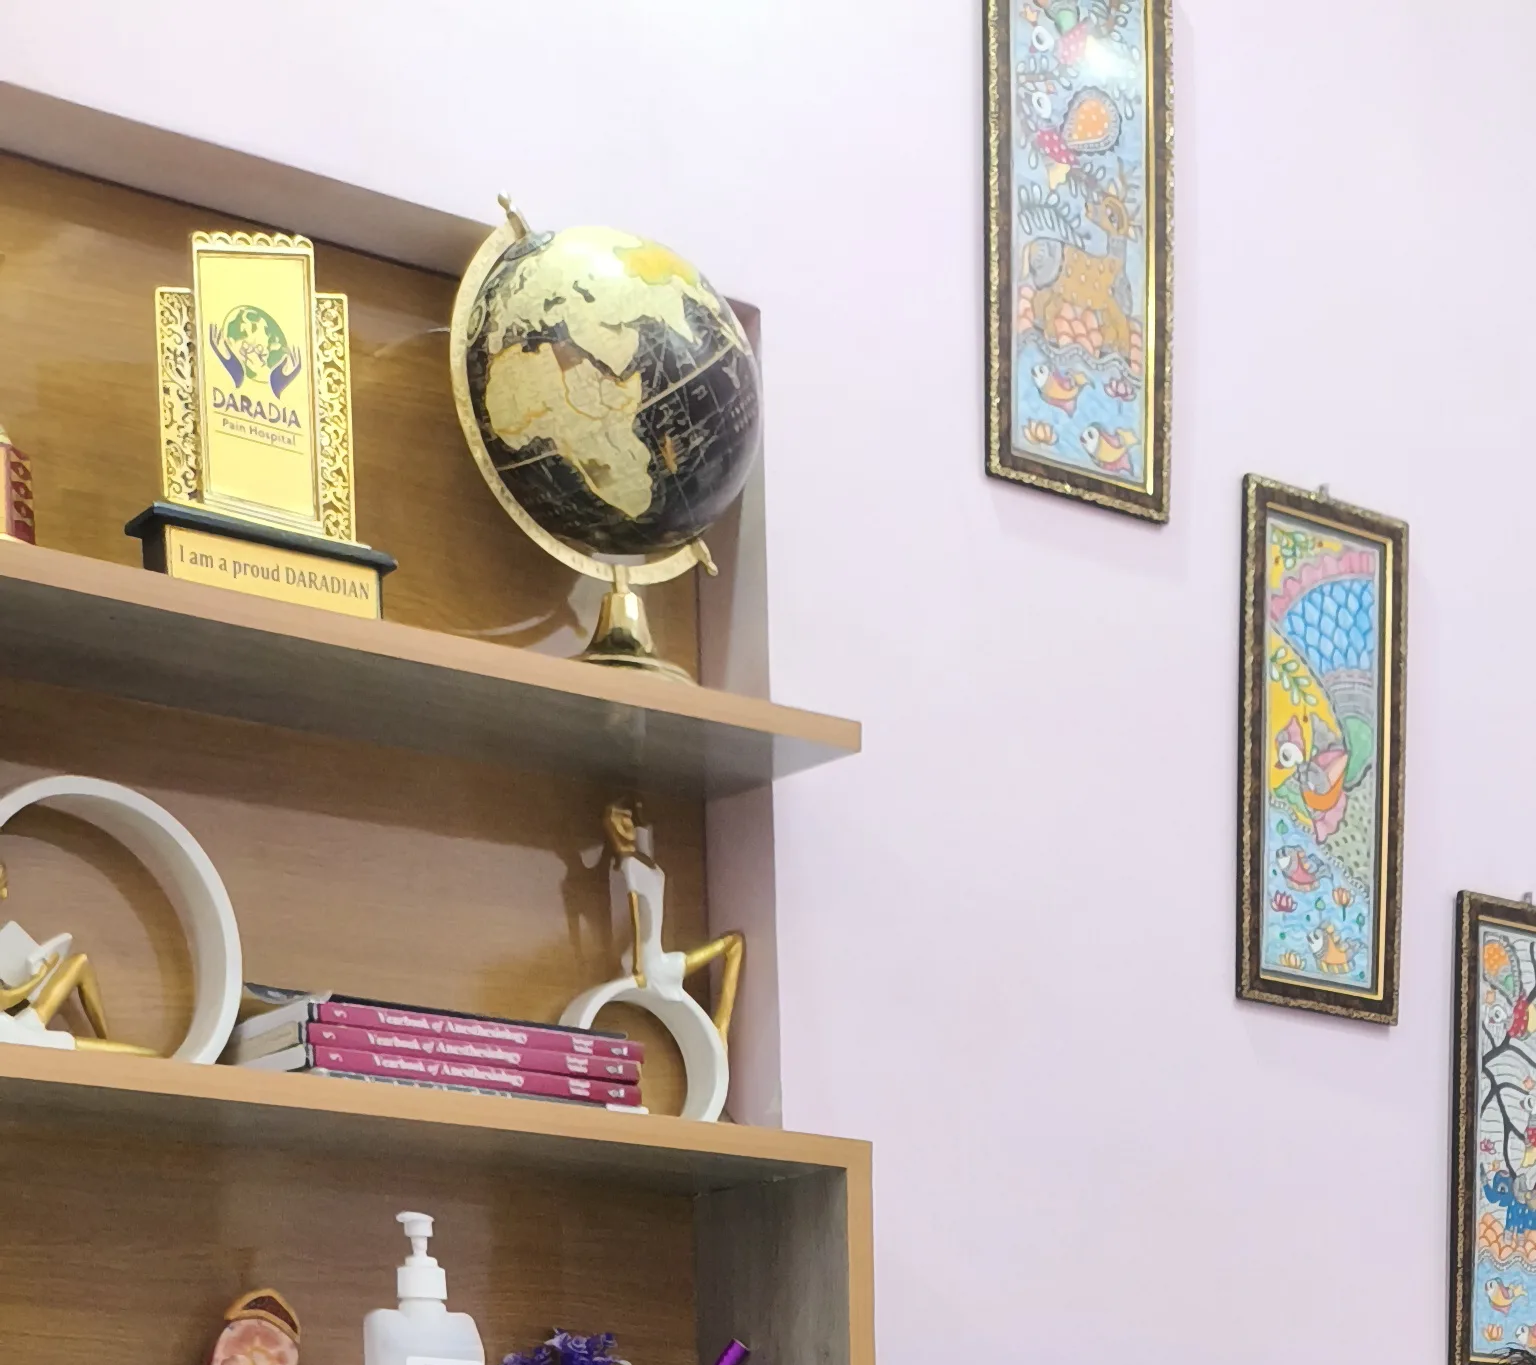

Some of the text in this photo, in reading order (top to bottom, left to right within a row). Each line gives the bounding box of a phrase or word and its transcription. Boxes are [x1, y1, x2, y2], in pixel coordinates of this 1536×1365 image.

[212, 387, 301, 428] DARADIA
[222, 418, 296, 446] Pain Hospital
[179, 544, 369, 599] I am a proud DARADIAN
